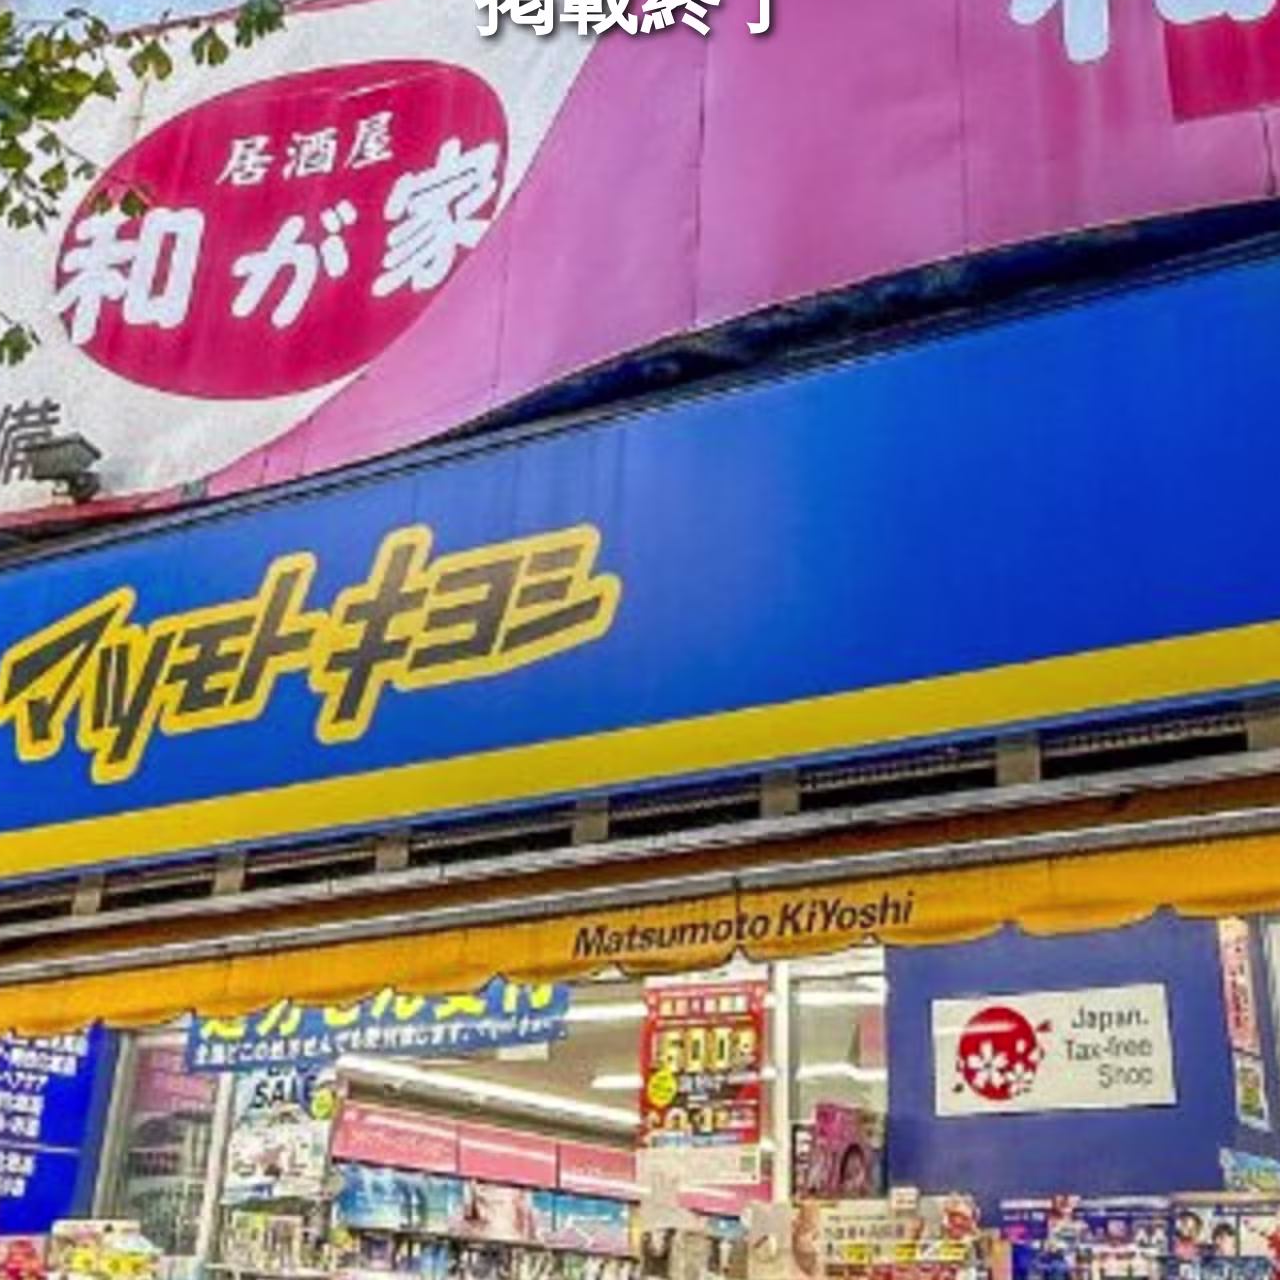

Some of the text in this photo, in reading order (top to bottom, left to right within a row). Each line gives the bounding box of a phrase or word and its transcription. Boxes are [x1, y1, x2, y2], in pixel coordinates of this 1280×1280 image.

[216, 110, 396, 187] 居酒屋
[54, 138, 504, 344] 和が家
[572, 912, 769, 960] Matsumoto
[1064, 1034, 1153, 1061] Tax-free
